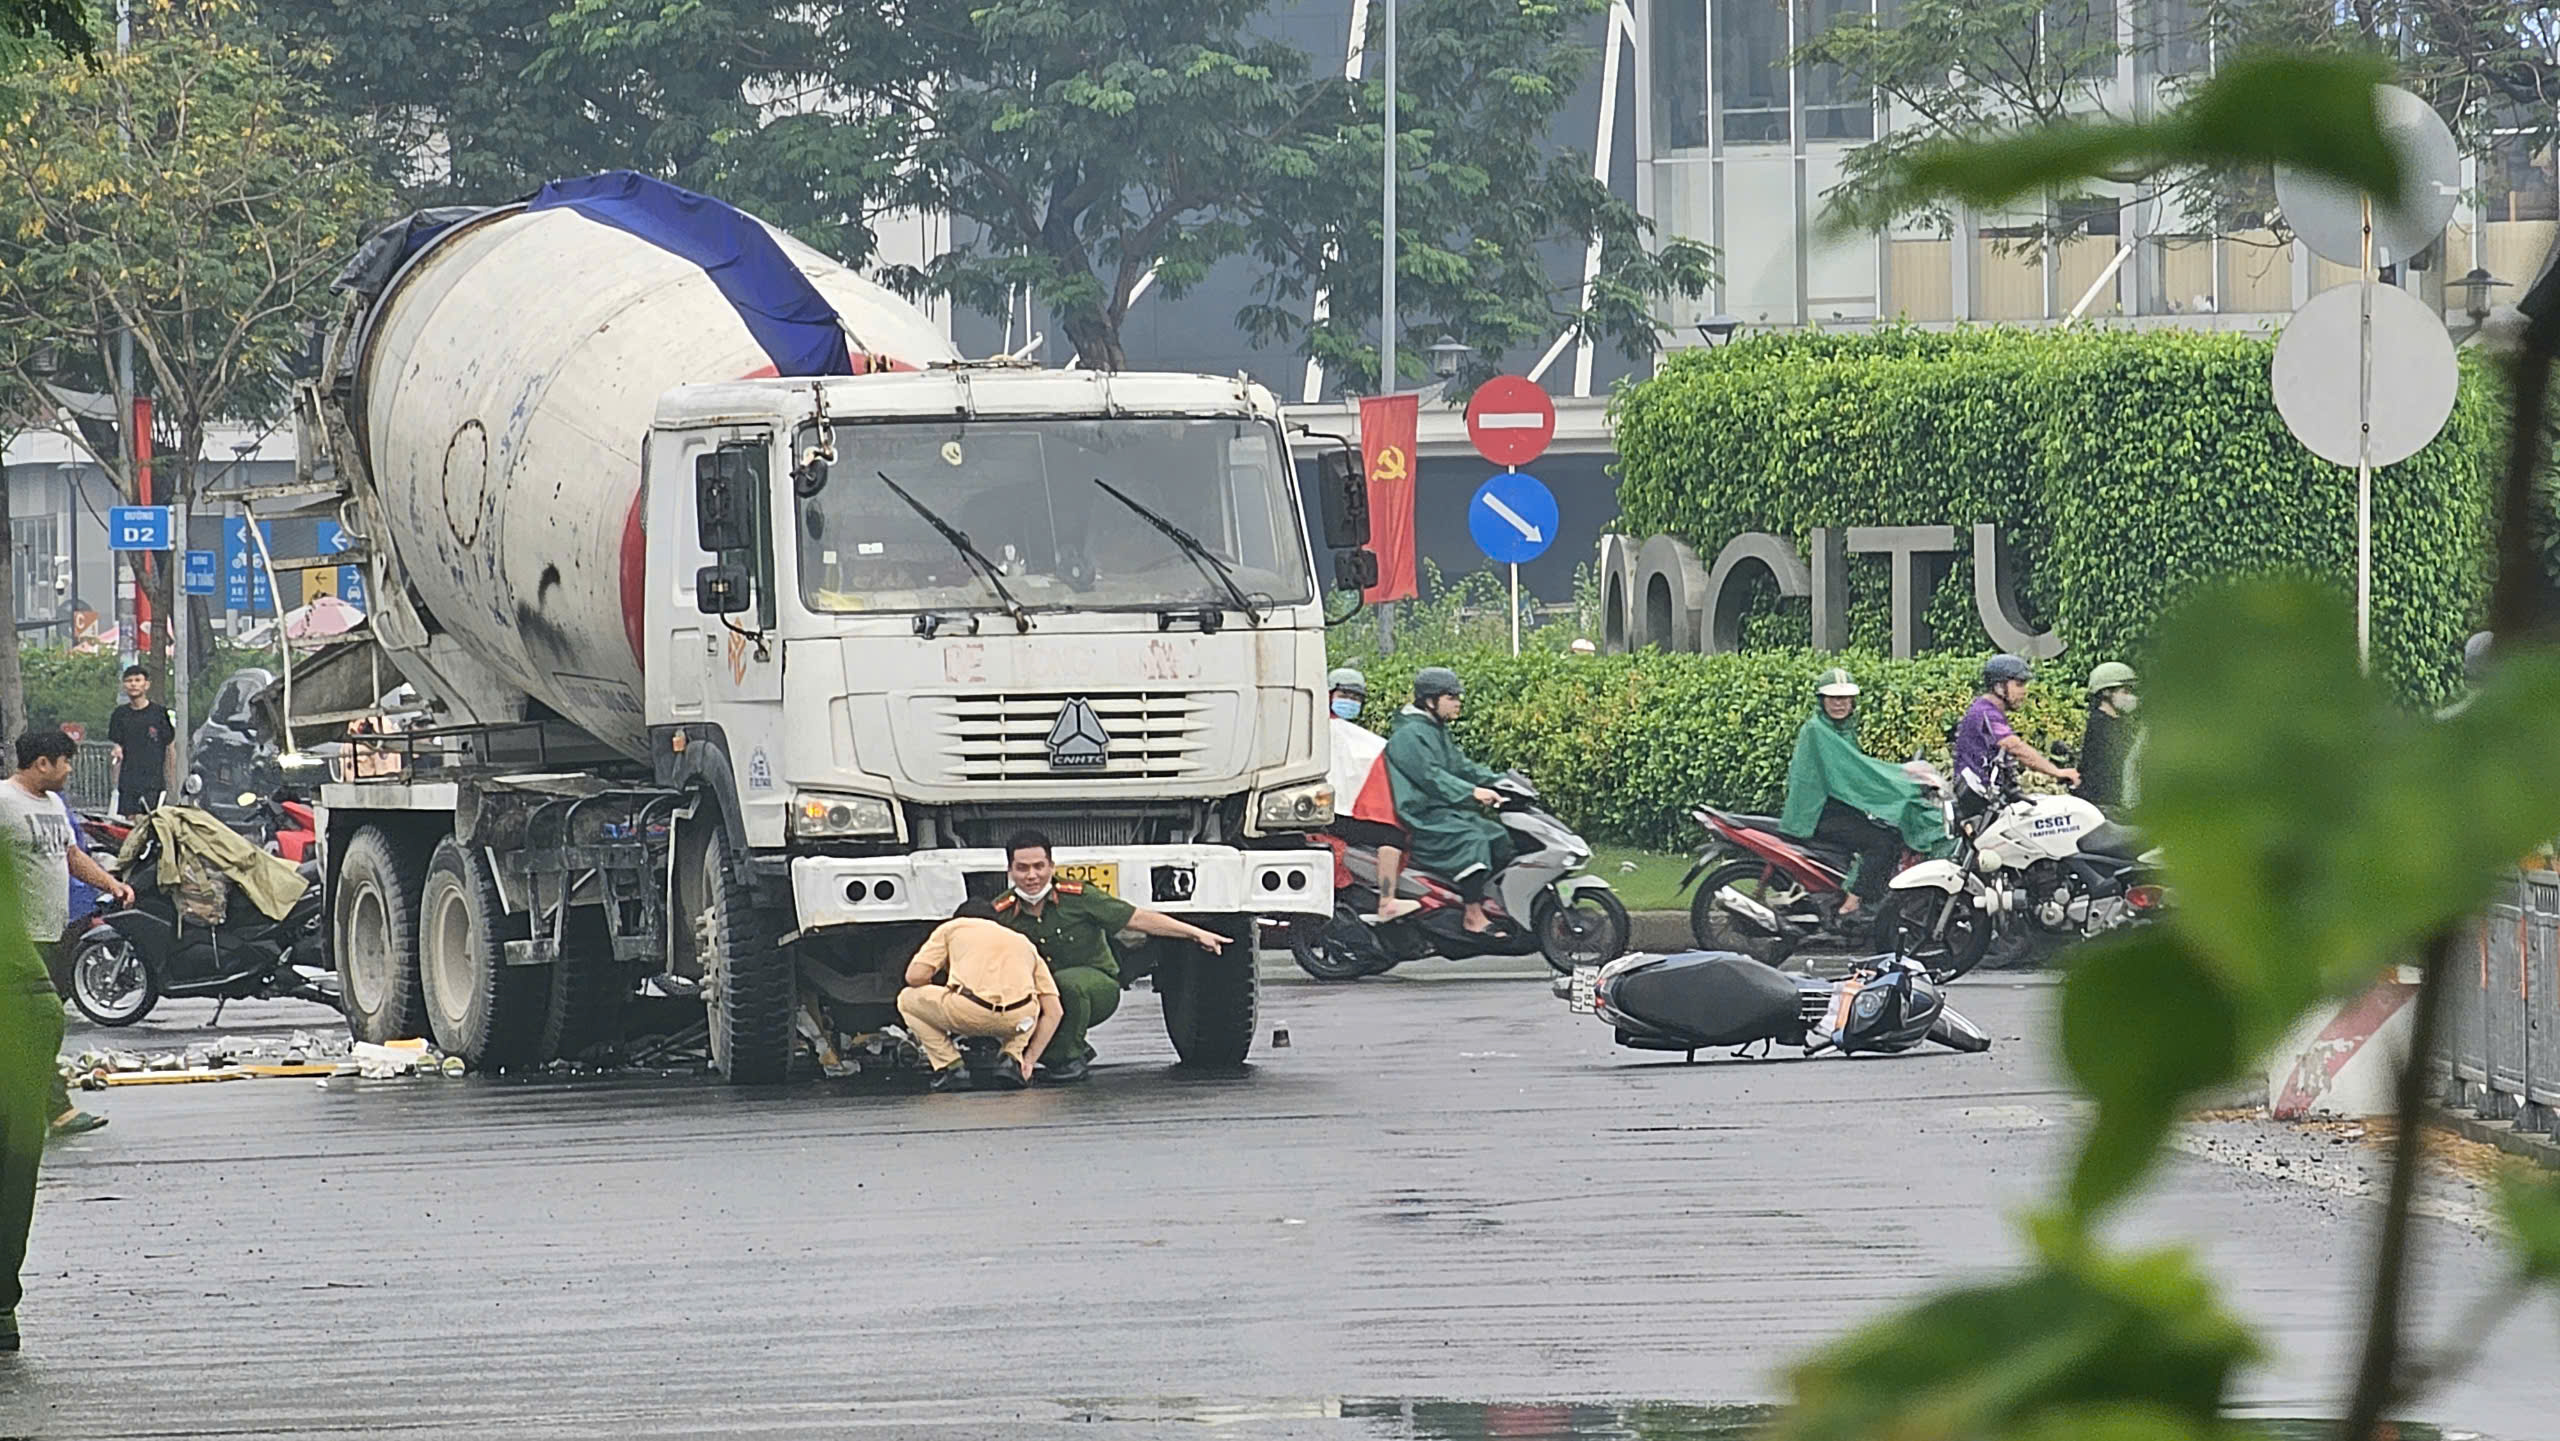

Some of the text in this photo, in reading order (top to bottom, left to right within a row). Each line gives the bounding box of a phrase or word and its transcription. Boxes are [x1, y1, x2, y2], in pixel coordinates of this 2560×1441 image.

[123, 527, 155, 542] D2
[1054, 754, 1105, 764] CNHTC
[2034, 815, 2071, 829] CSGT
